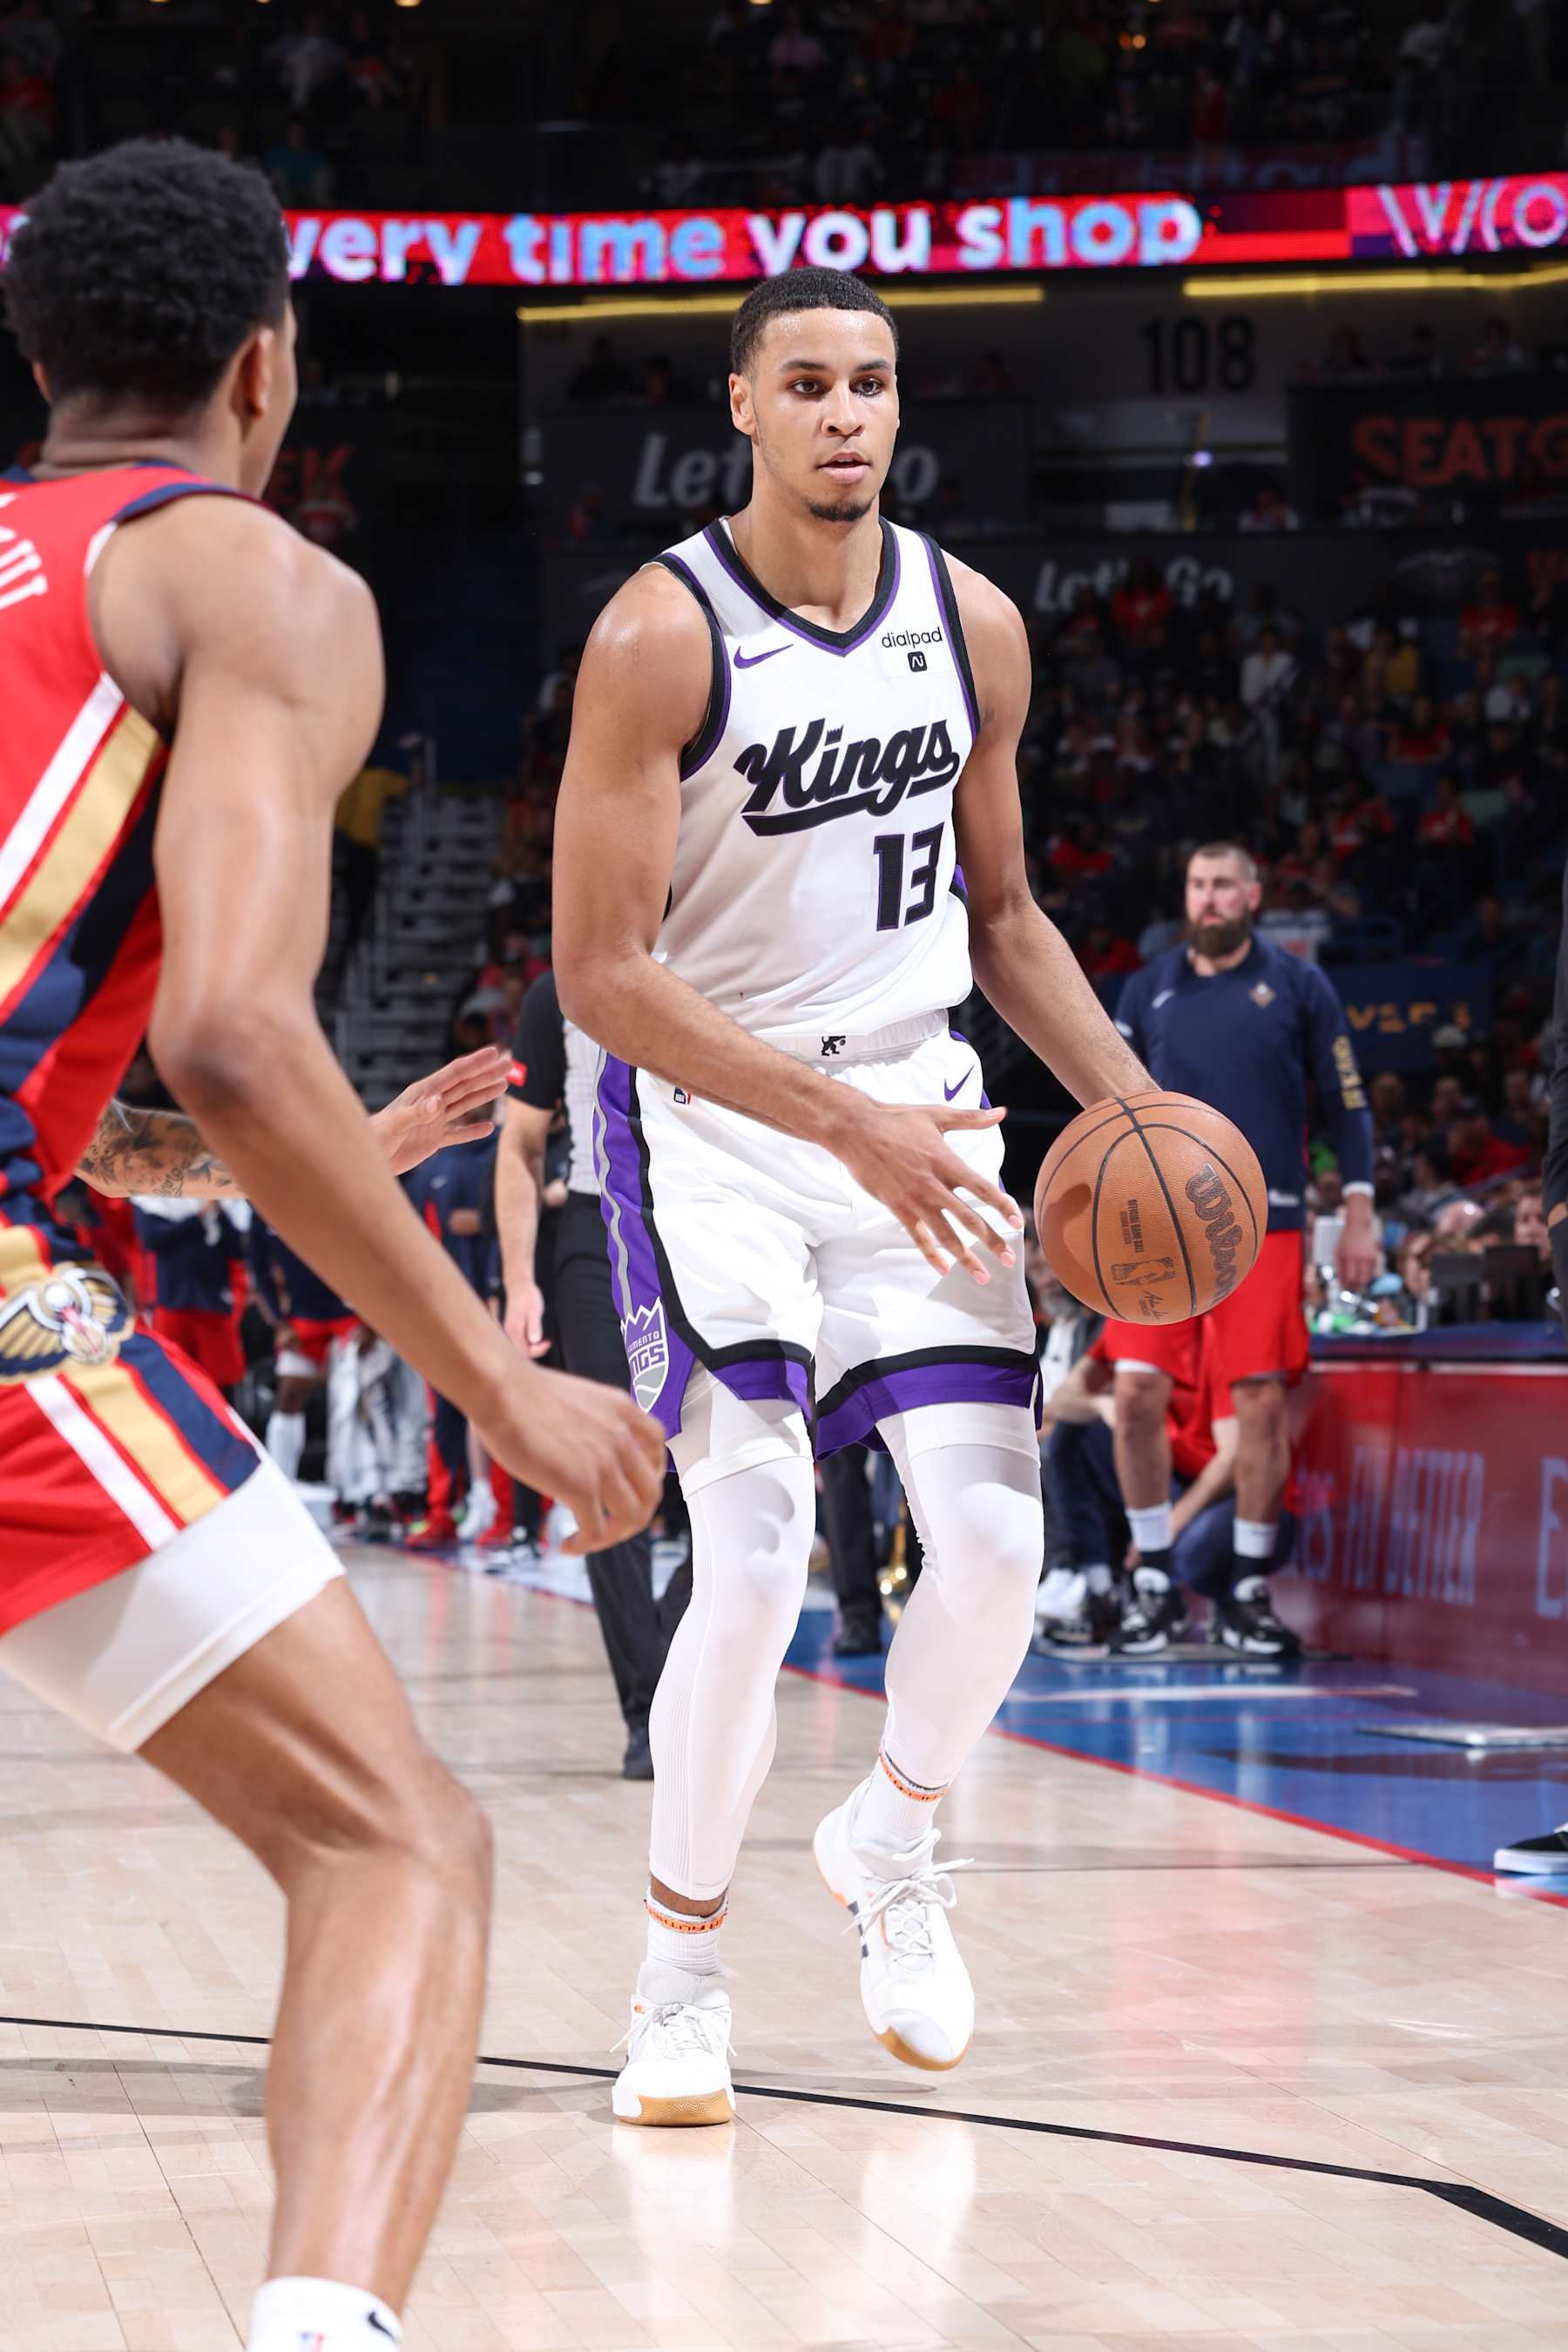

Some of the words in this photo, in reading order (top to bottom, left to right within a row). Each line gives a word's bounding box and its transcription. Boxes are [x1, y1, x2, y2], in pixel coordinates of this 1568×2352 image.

[503, 213, 726, 285] time
[956, 196, 1203, 270] shop
[1139, 317, 1256, 394] 108
[882, 625, 943, 649] dialpad
[733, 718, 960, 836] Kings
[873, 821, 945, 931] 13
